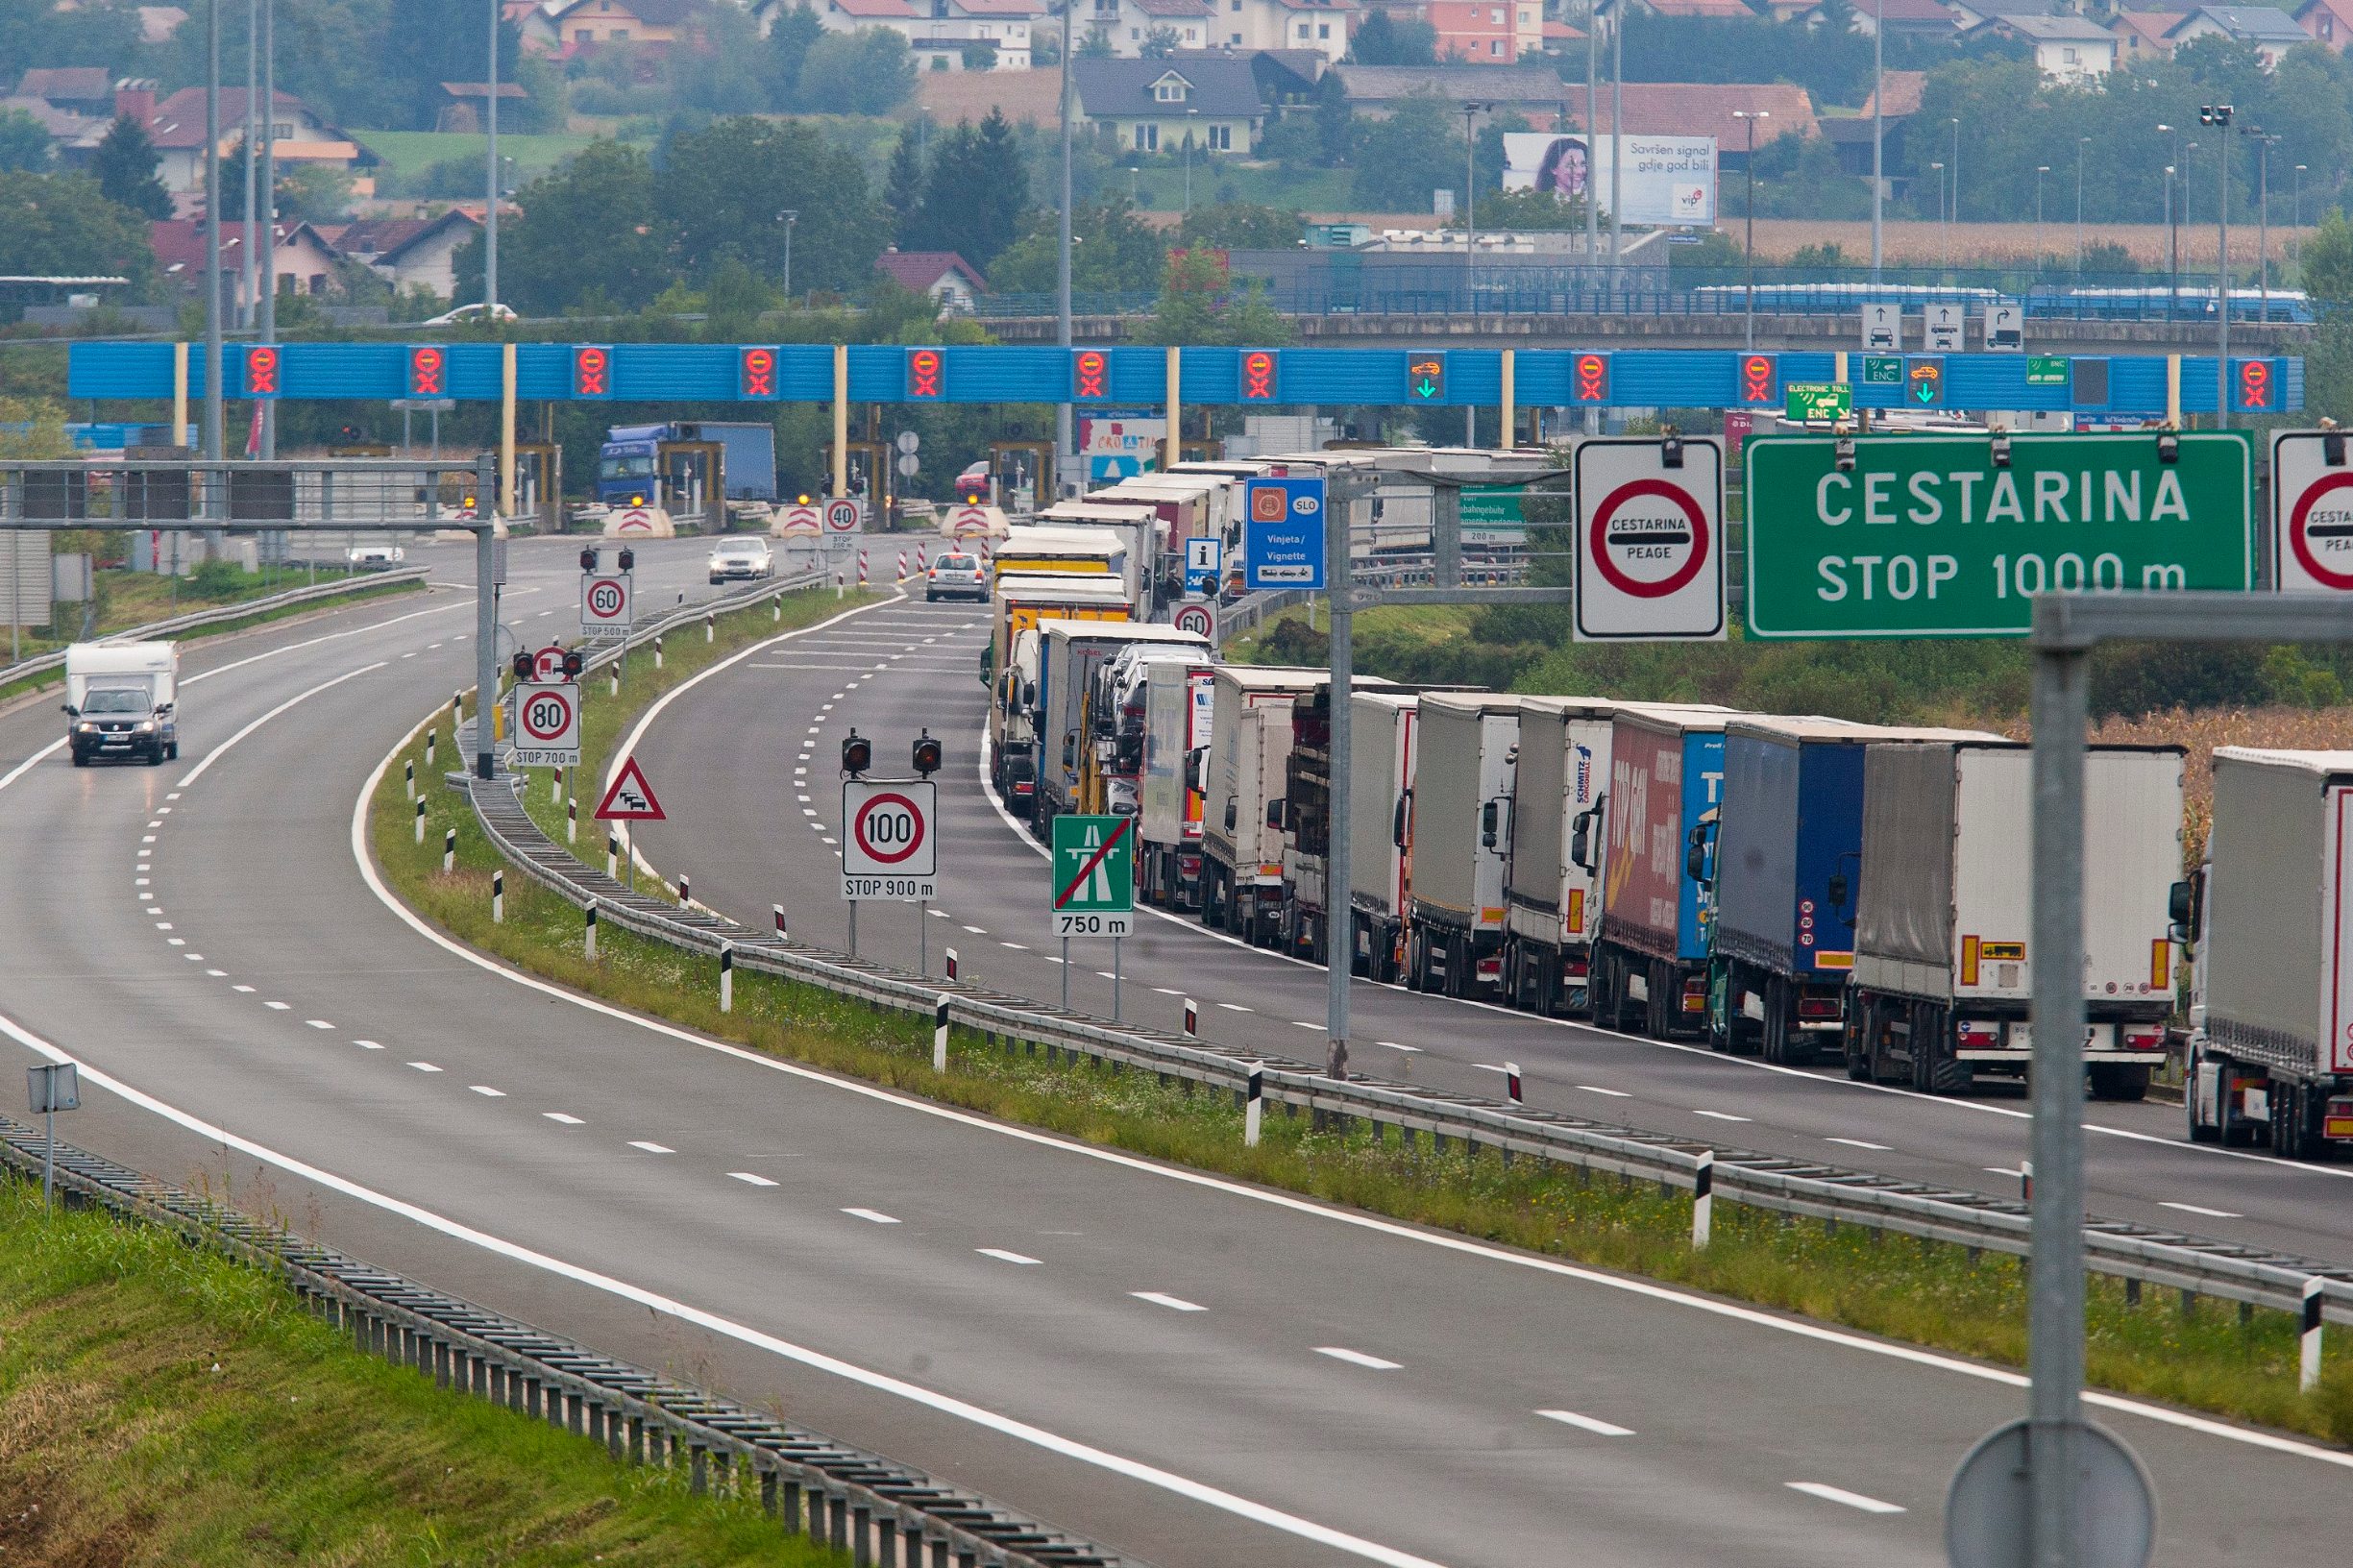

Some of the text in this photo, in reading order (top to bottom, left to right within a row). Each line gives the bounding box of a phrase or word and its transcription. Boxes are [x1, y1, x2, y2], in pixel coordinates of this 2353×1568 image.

[1630, 142, 1709, 158] Savršen signal
[1638, 159, 1709, 173] gdje god bili
[1681, 194, 1698, 207] vip
[1873, 371, 1896, 380] ENC
[1788, 384, 1850, 393] ELECTRONIC TOLL
[1807, 407, 1829, 419] ENC
[1816, 469, 2190, 527] CESTARINA
[1296, 501, 1315, 510] SLO
[834, 508, 851, 524] 40
[1611, 518, 1686, 530] CESTARINA
[1266, 551, 1306, 562] Vignette
[1627, 547, 1673, 558] PEAGE
[1817, 551, 2186, 602] STOP 1000 m
[596, 590, 617, 608] 60
[582, 626, 602, 635] STOP
[604, 626, 621, 635] 500
[1183, 615, 1205, 634] 60
[533, 703, 561, 728] 80
[516, 751, 577, 764] STOP 700 m
[1577, 761, 1585, 803] SCHMITZ
[868, 813, 911, 844] 100
[846, 880, 933, 895] STOP 900 m
[1062, 916, 1125, 934] 750 m
